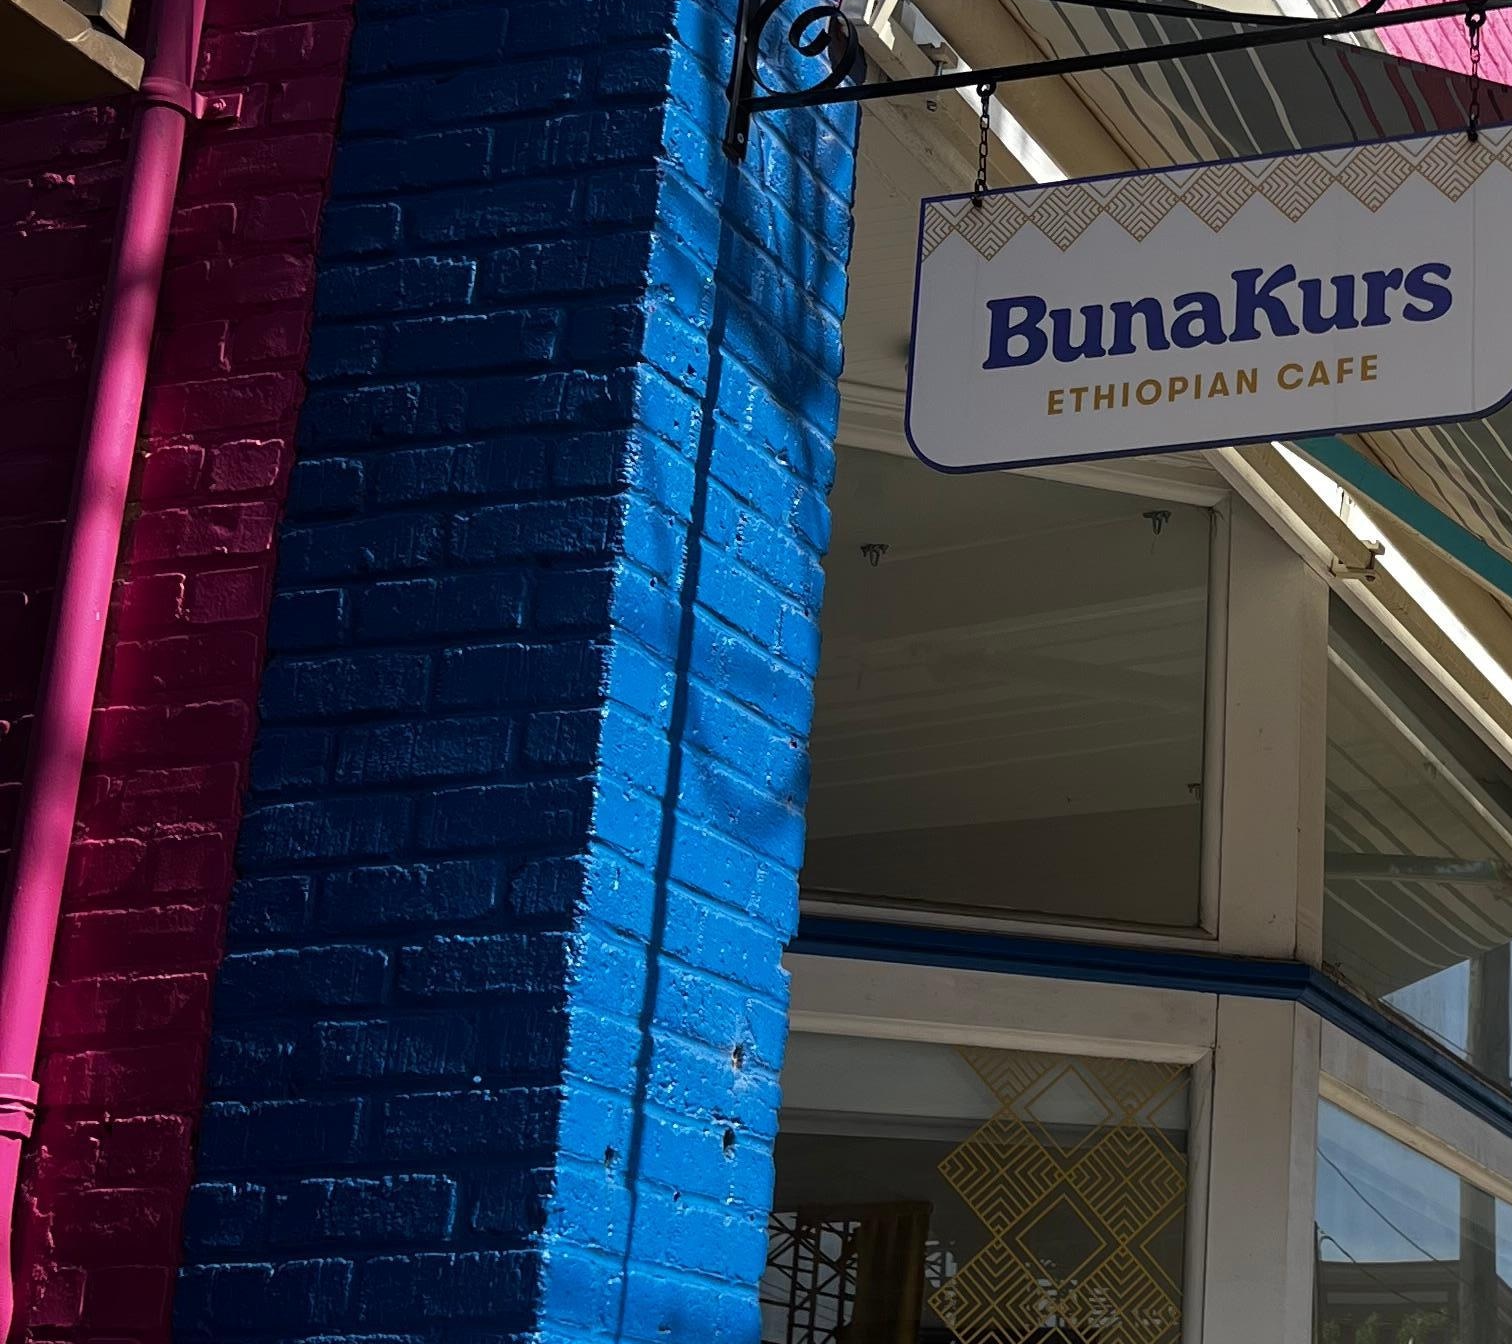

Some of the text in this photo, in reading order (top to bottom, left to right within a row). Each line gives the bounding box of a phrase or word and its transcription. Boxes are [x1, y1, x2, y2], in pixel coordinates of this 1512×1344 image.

[983, 263, 1453, 369] BunaKurs
[1047, 355, 1379, 415] ETHIOPIAN CAFE
